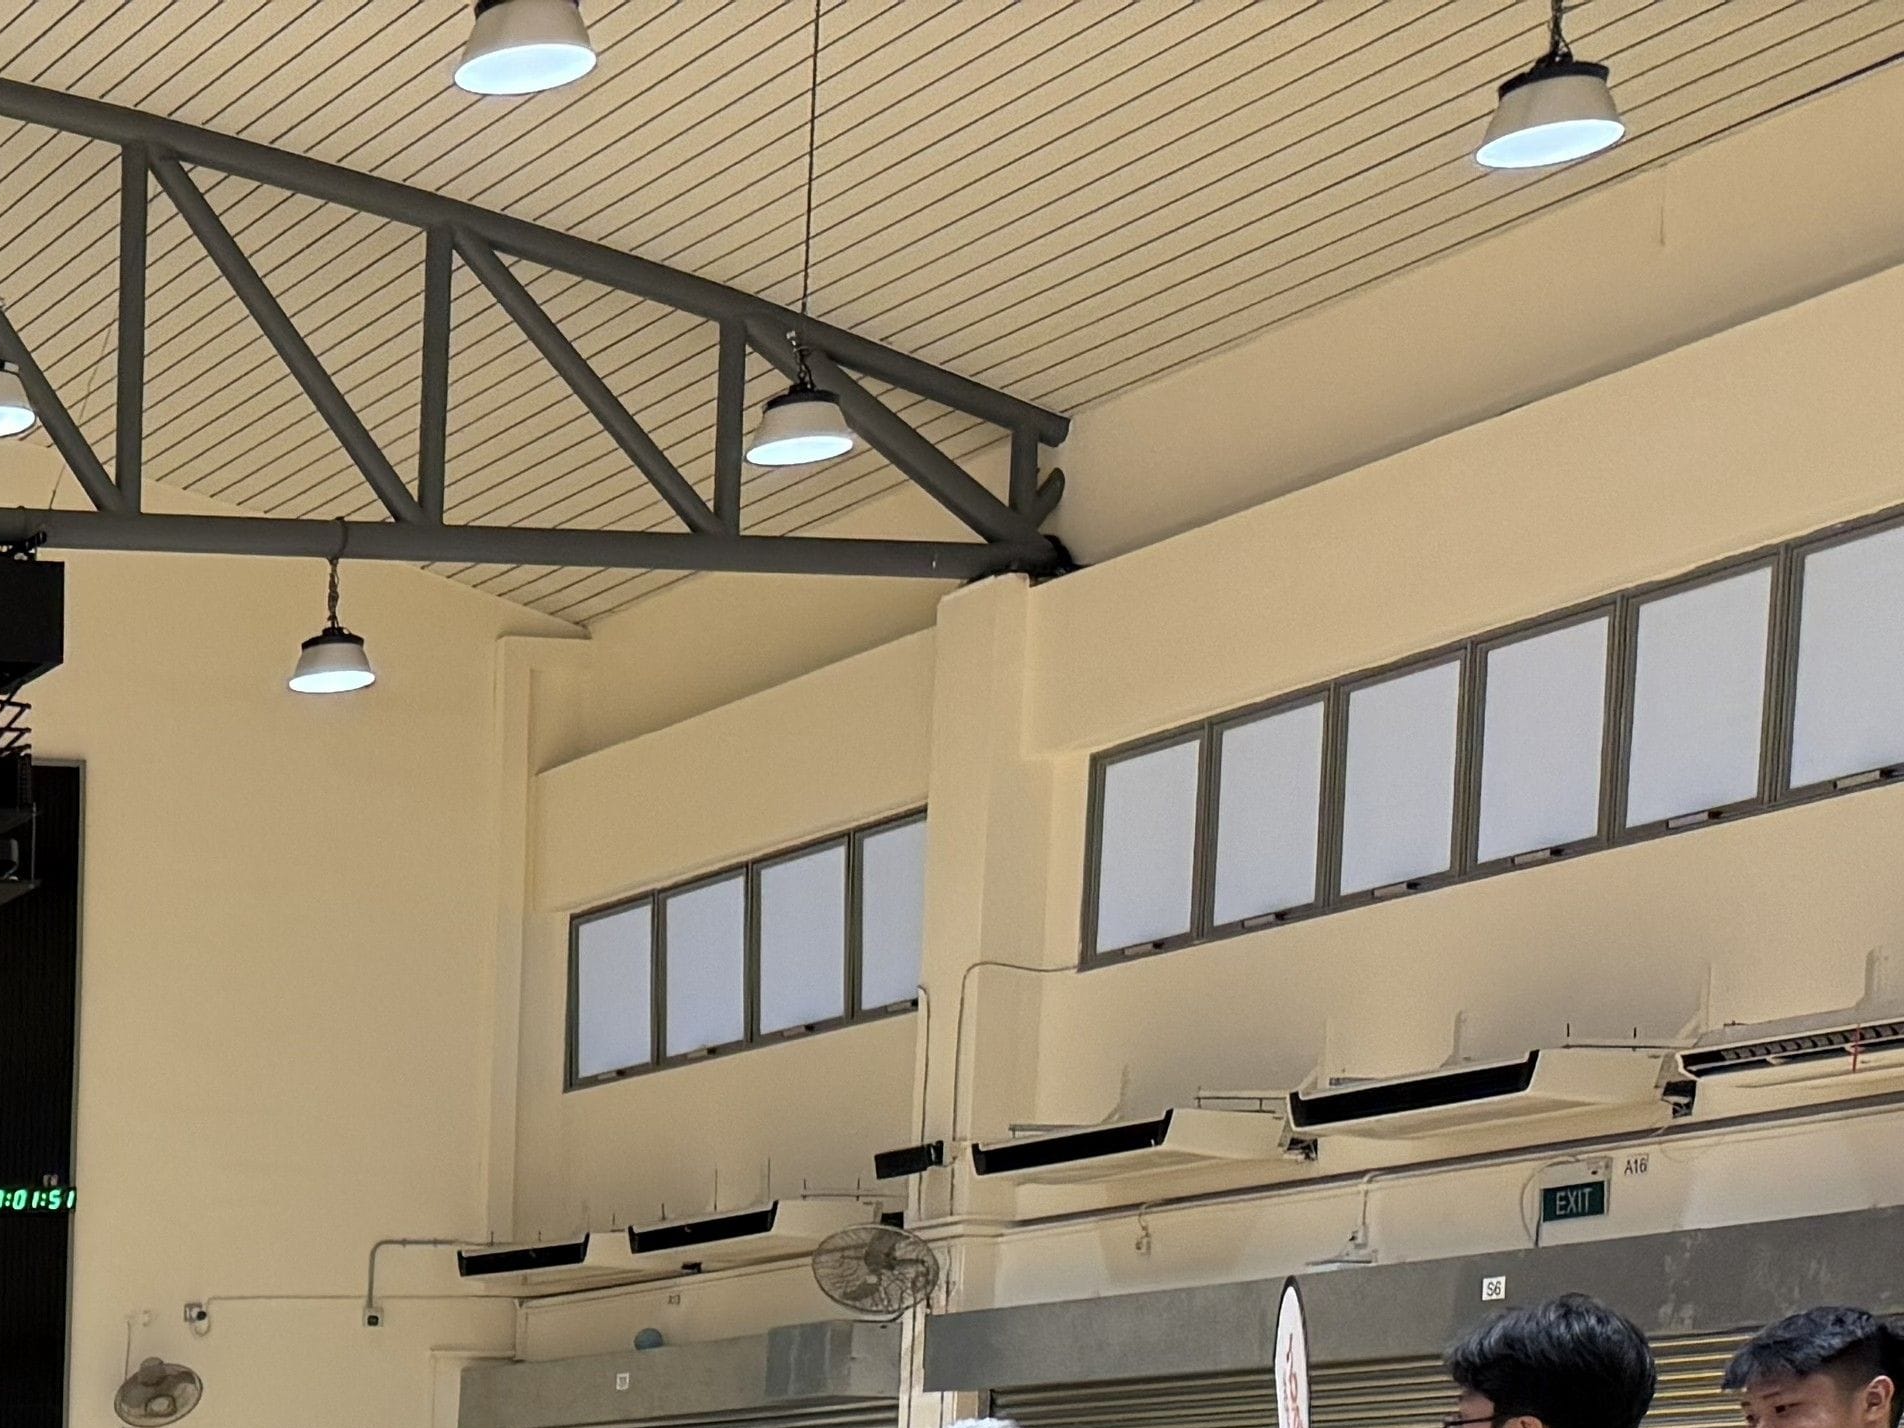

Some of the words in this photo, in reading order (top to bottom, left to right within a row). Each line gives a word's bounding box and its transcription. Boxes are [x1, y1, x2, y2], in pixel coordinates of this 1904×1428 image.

[1624, 1158, 1649, 1175] A16
[1555, 1188, 1594, 1216] EXIT
[1486, 1281, 1502, 1298] S6
